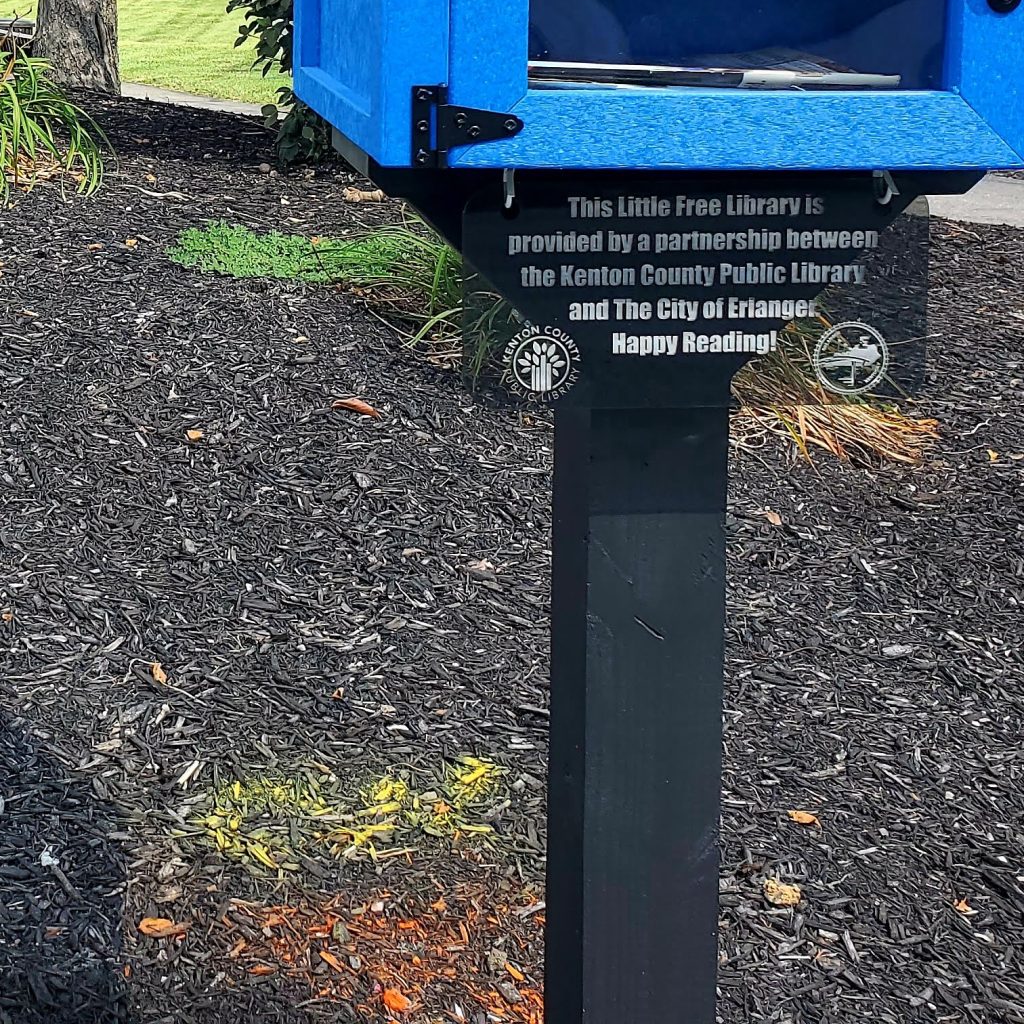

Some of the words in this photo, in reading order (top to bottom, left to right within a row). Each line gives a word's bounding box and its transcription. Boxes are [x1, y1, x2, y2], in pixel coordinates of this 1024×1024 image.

[568, 196, 613, 218] This
[617, 196, 671, 218] Little
[676, 195, 722, 217] Free
[726, 194, 801, 217] Library
[805, 194, 825, 216] is
[508, 230, 604, 255] provided
[608, 230, 634, 254] by
[637, 233, 651, 252] a
[655, 229, 782, 254] partnership
[786, 228, 879, 250] between
[521, 265, 556, 287] the
[560, 265, 636, 287] Kenton
[640, 263, 716, 287] County
[719, 262, 787, 285] Public
[791, 262, 865, 285] Library
[568, 299, 610, 321] and
[613, 298, 653, 321] The
[657, 297, 699, 322] City
[702, 297, 725, 319] of
[502, 325, 540, 363] KENTON
[544, 326, 581, 362] COUNTY
[612, 332, 679, 356] Happy
[682, 330, 777, 355] Reading!
[502, 368, 536, 402] PUBLIC
[541, 367, 581, 403] LIBRARY
